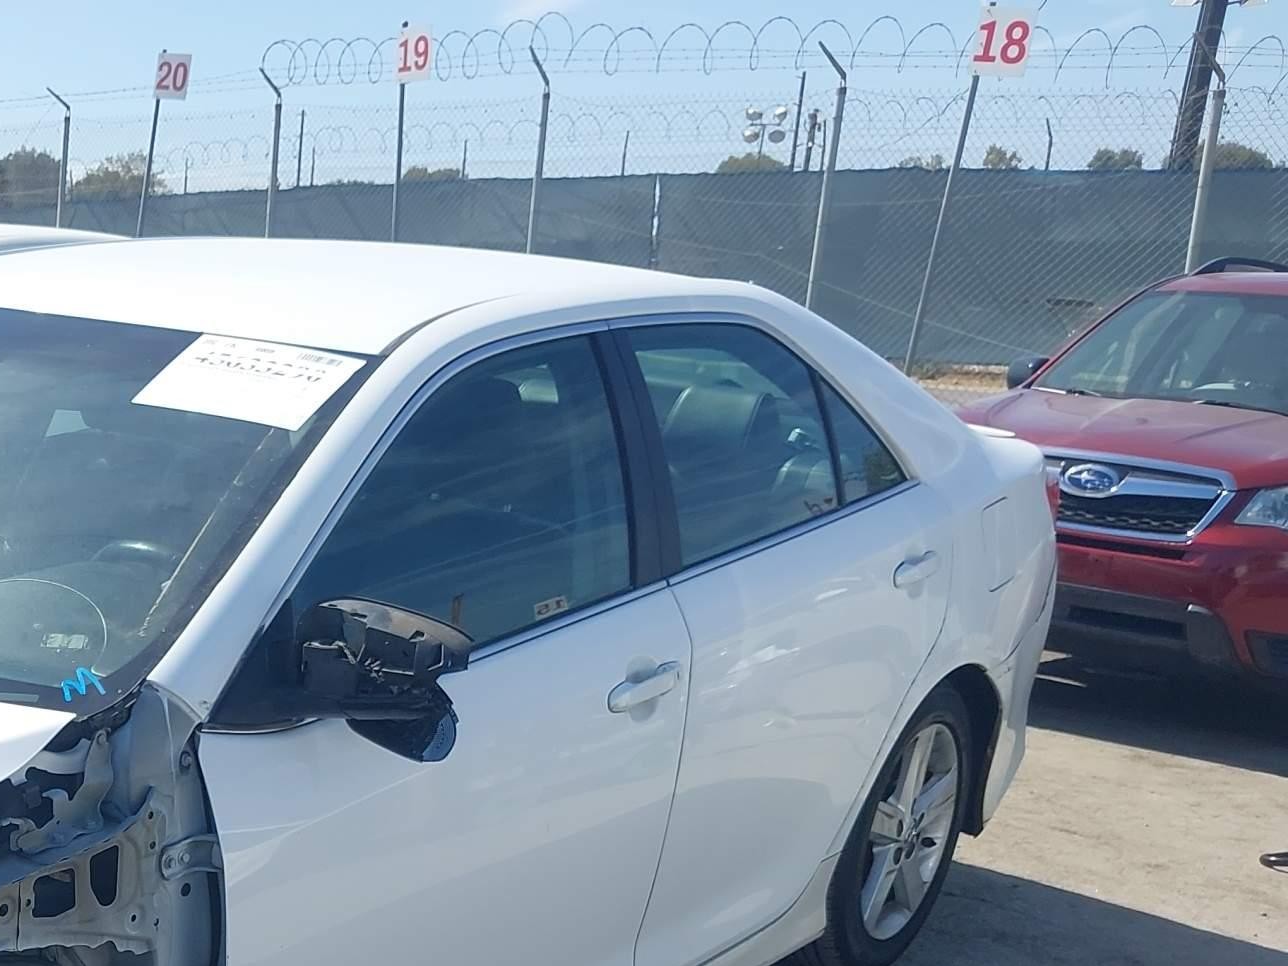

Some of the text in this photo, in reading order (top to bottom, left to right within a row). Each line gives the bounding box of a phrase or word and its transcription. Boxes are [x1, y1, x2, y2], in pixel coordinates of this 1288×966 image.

[398, 35, 429, 73] 19
[972, 20, 1030, 65] 18
[155, 60, 188, 92] 20
[61, 667, 106, 702] M
